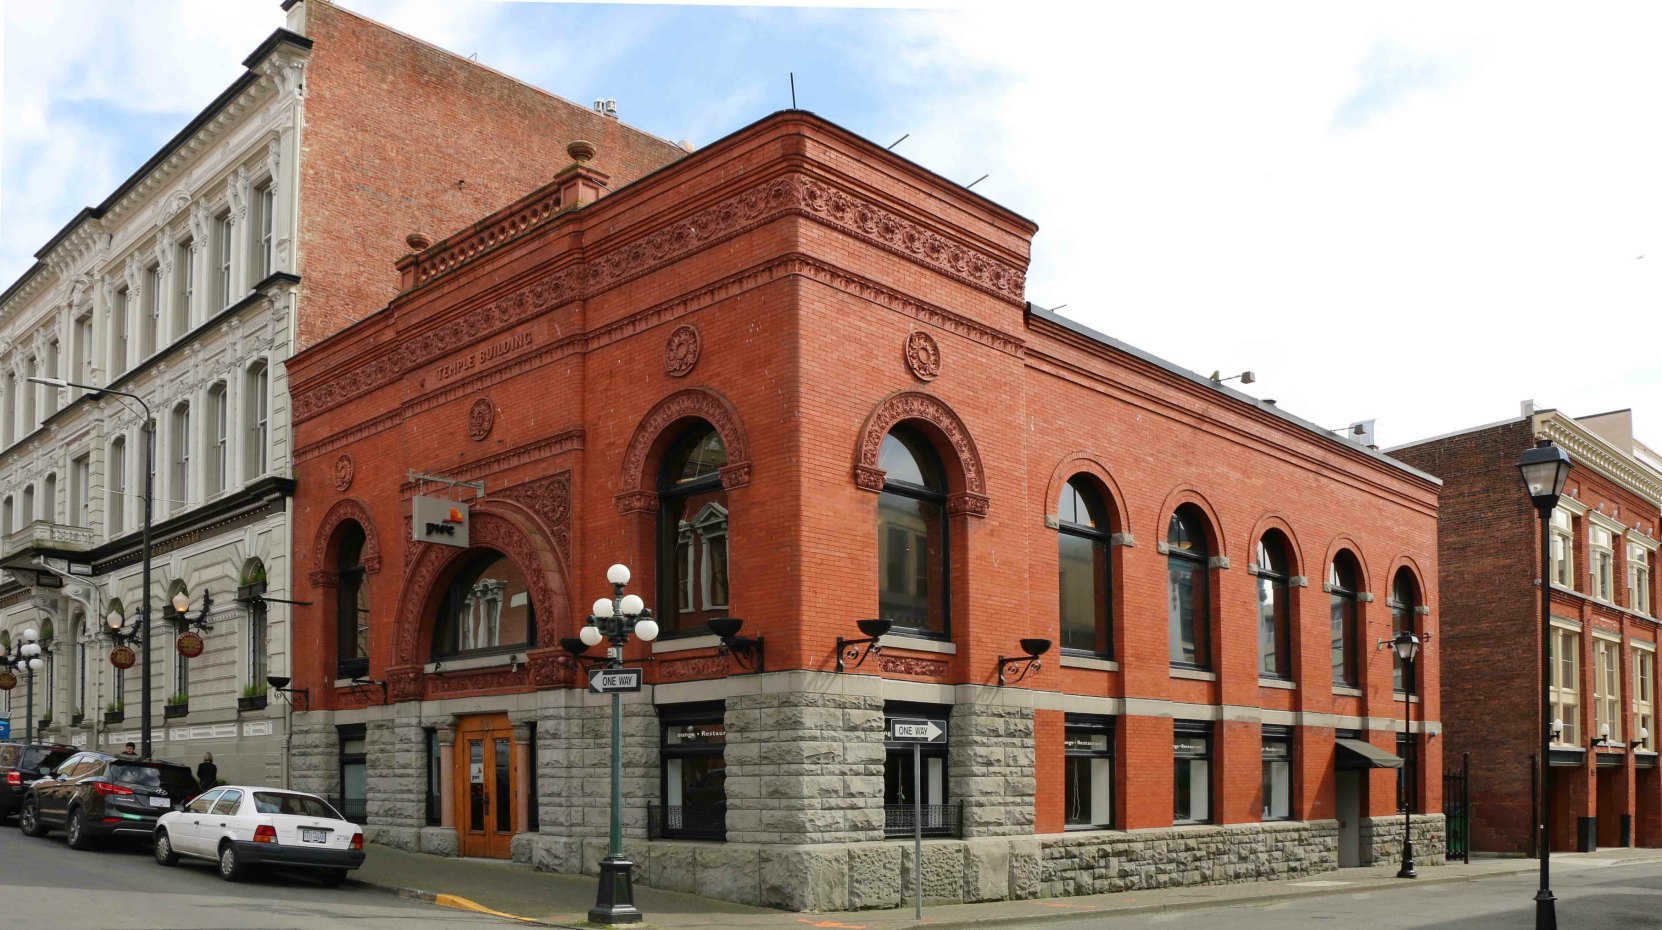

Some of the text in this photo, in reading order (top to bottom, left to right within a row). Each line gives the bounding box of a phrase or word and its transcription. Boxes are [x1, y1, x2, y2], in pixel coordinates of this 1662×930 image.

[437, 332, 532, 380] TEMPLE BUILDING
[426, 522, 455, 537] pwc
[602, 676, 633, 686] ONE WAY
[898, 726, 928, 736] ONE WAY
